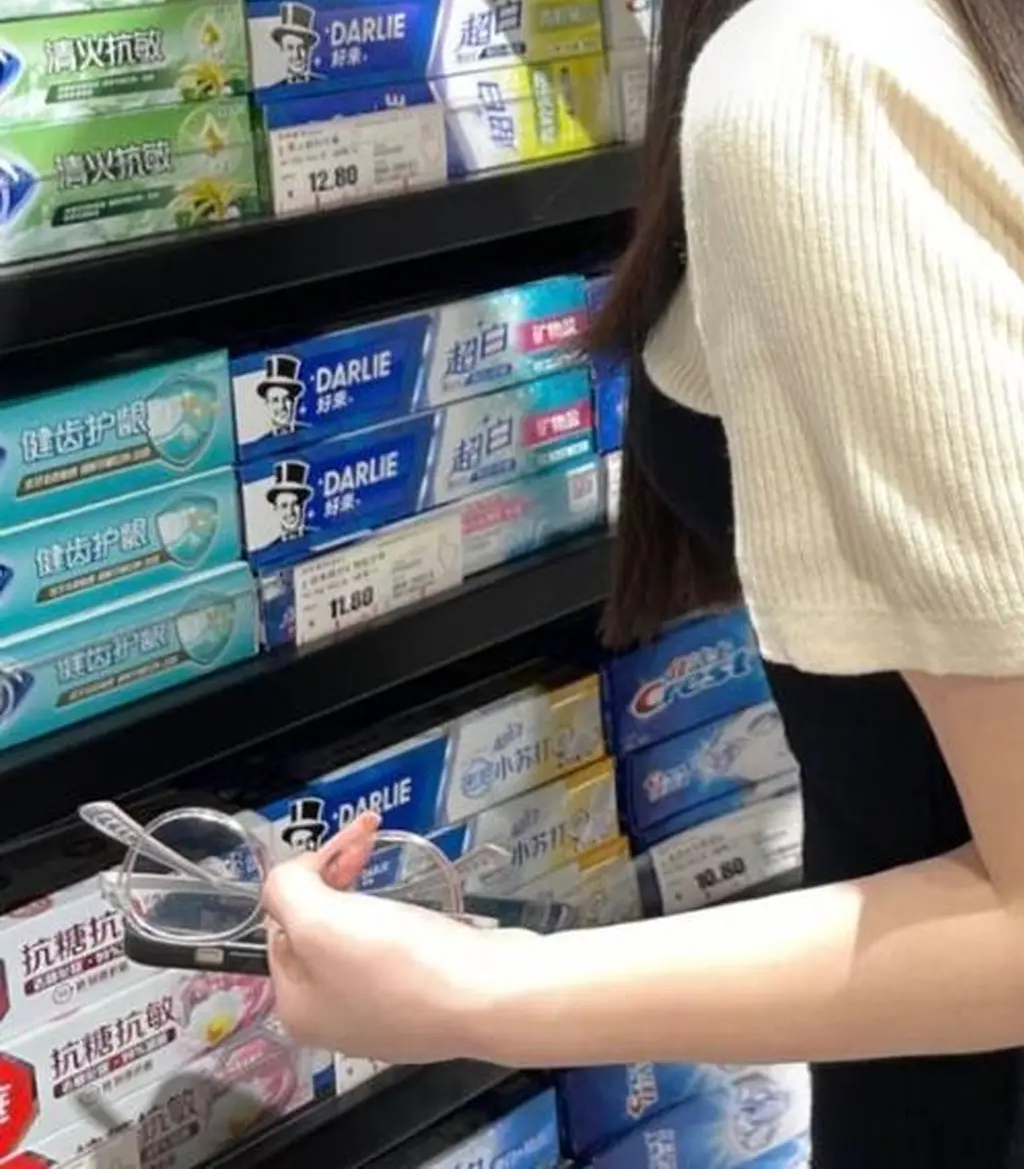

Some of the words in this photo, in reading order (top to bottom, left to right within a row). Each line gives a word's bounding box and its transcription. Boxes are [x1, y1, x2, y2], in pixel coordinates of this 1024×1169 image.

[44, 28, 166, 74] 清火抗敏
[330, 13, 407, 46] DARLIE
[57, 139, 173, 191] 清火抗敏
[308, 164, 359, 193] 12.80
[316, 350, 392, 393] DARLIE
[445, 321, 508, 376] 超白
[451, 417, 513, 474] 超白
[324, 451, 399, 498] DARLIE
[21, 911, 127, 977] 抗糖抗
[51, 995, 177, 1081] 抗糖抗敏
